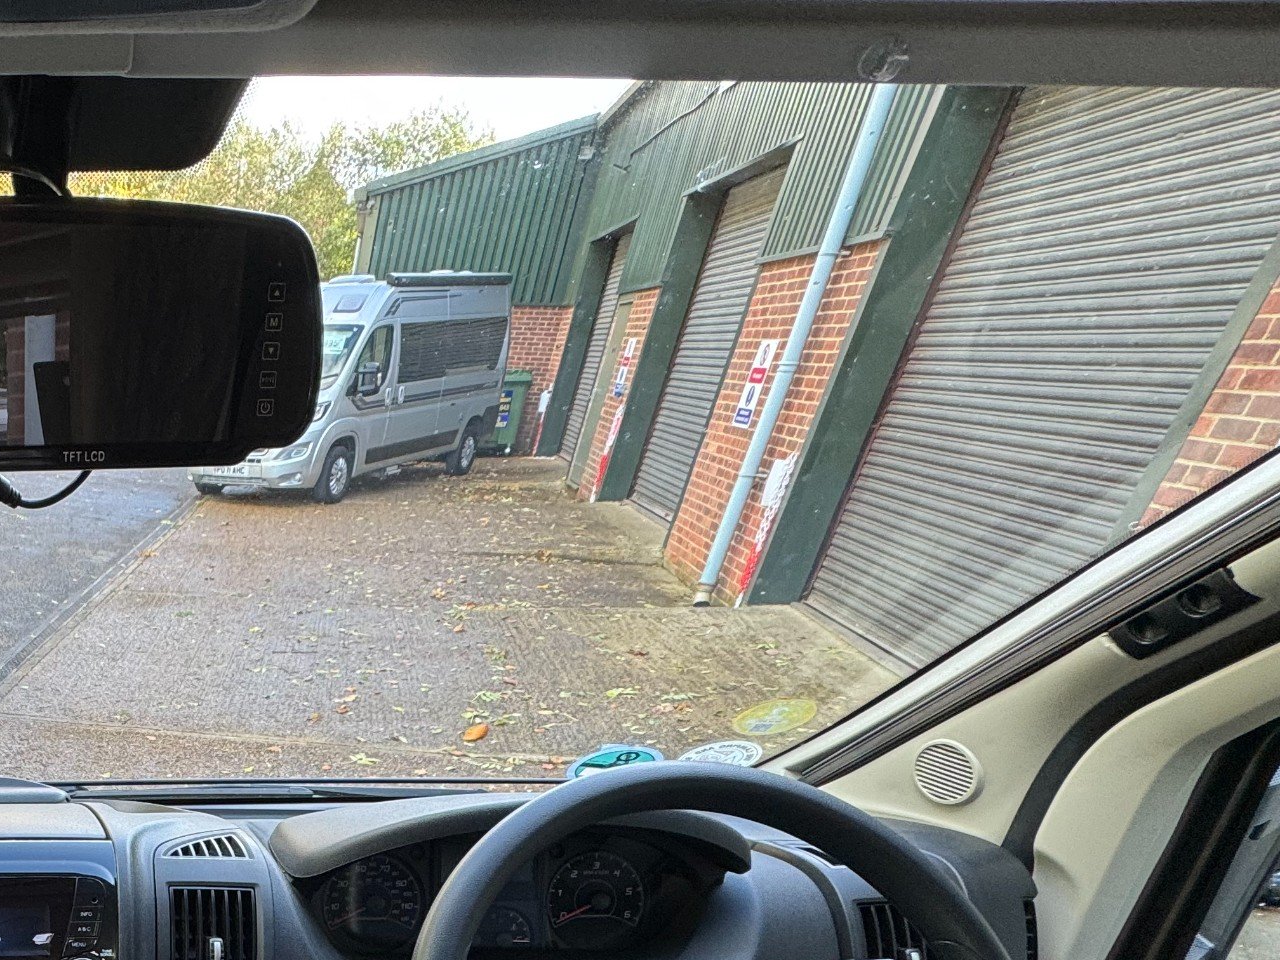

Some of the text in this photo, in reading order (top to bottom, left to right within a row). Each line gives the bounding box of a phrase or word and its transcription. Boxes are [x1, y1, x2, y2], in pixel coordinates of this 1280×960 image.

[63, 450, 106, 462] TFT LCD
[570, 870, 579, 878] 2
[625, 887, 633, 895] 5
